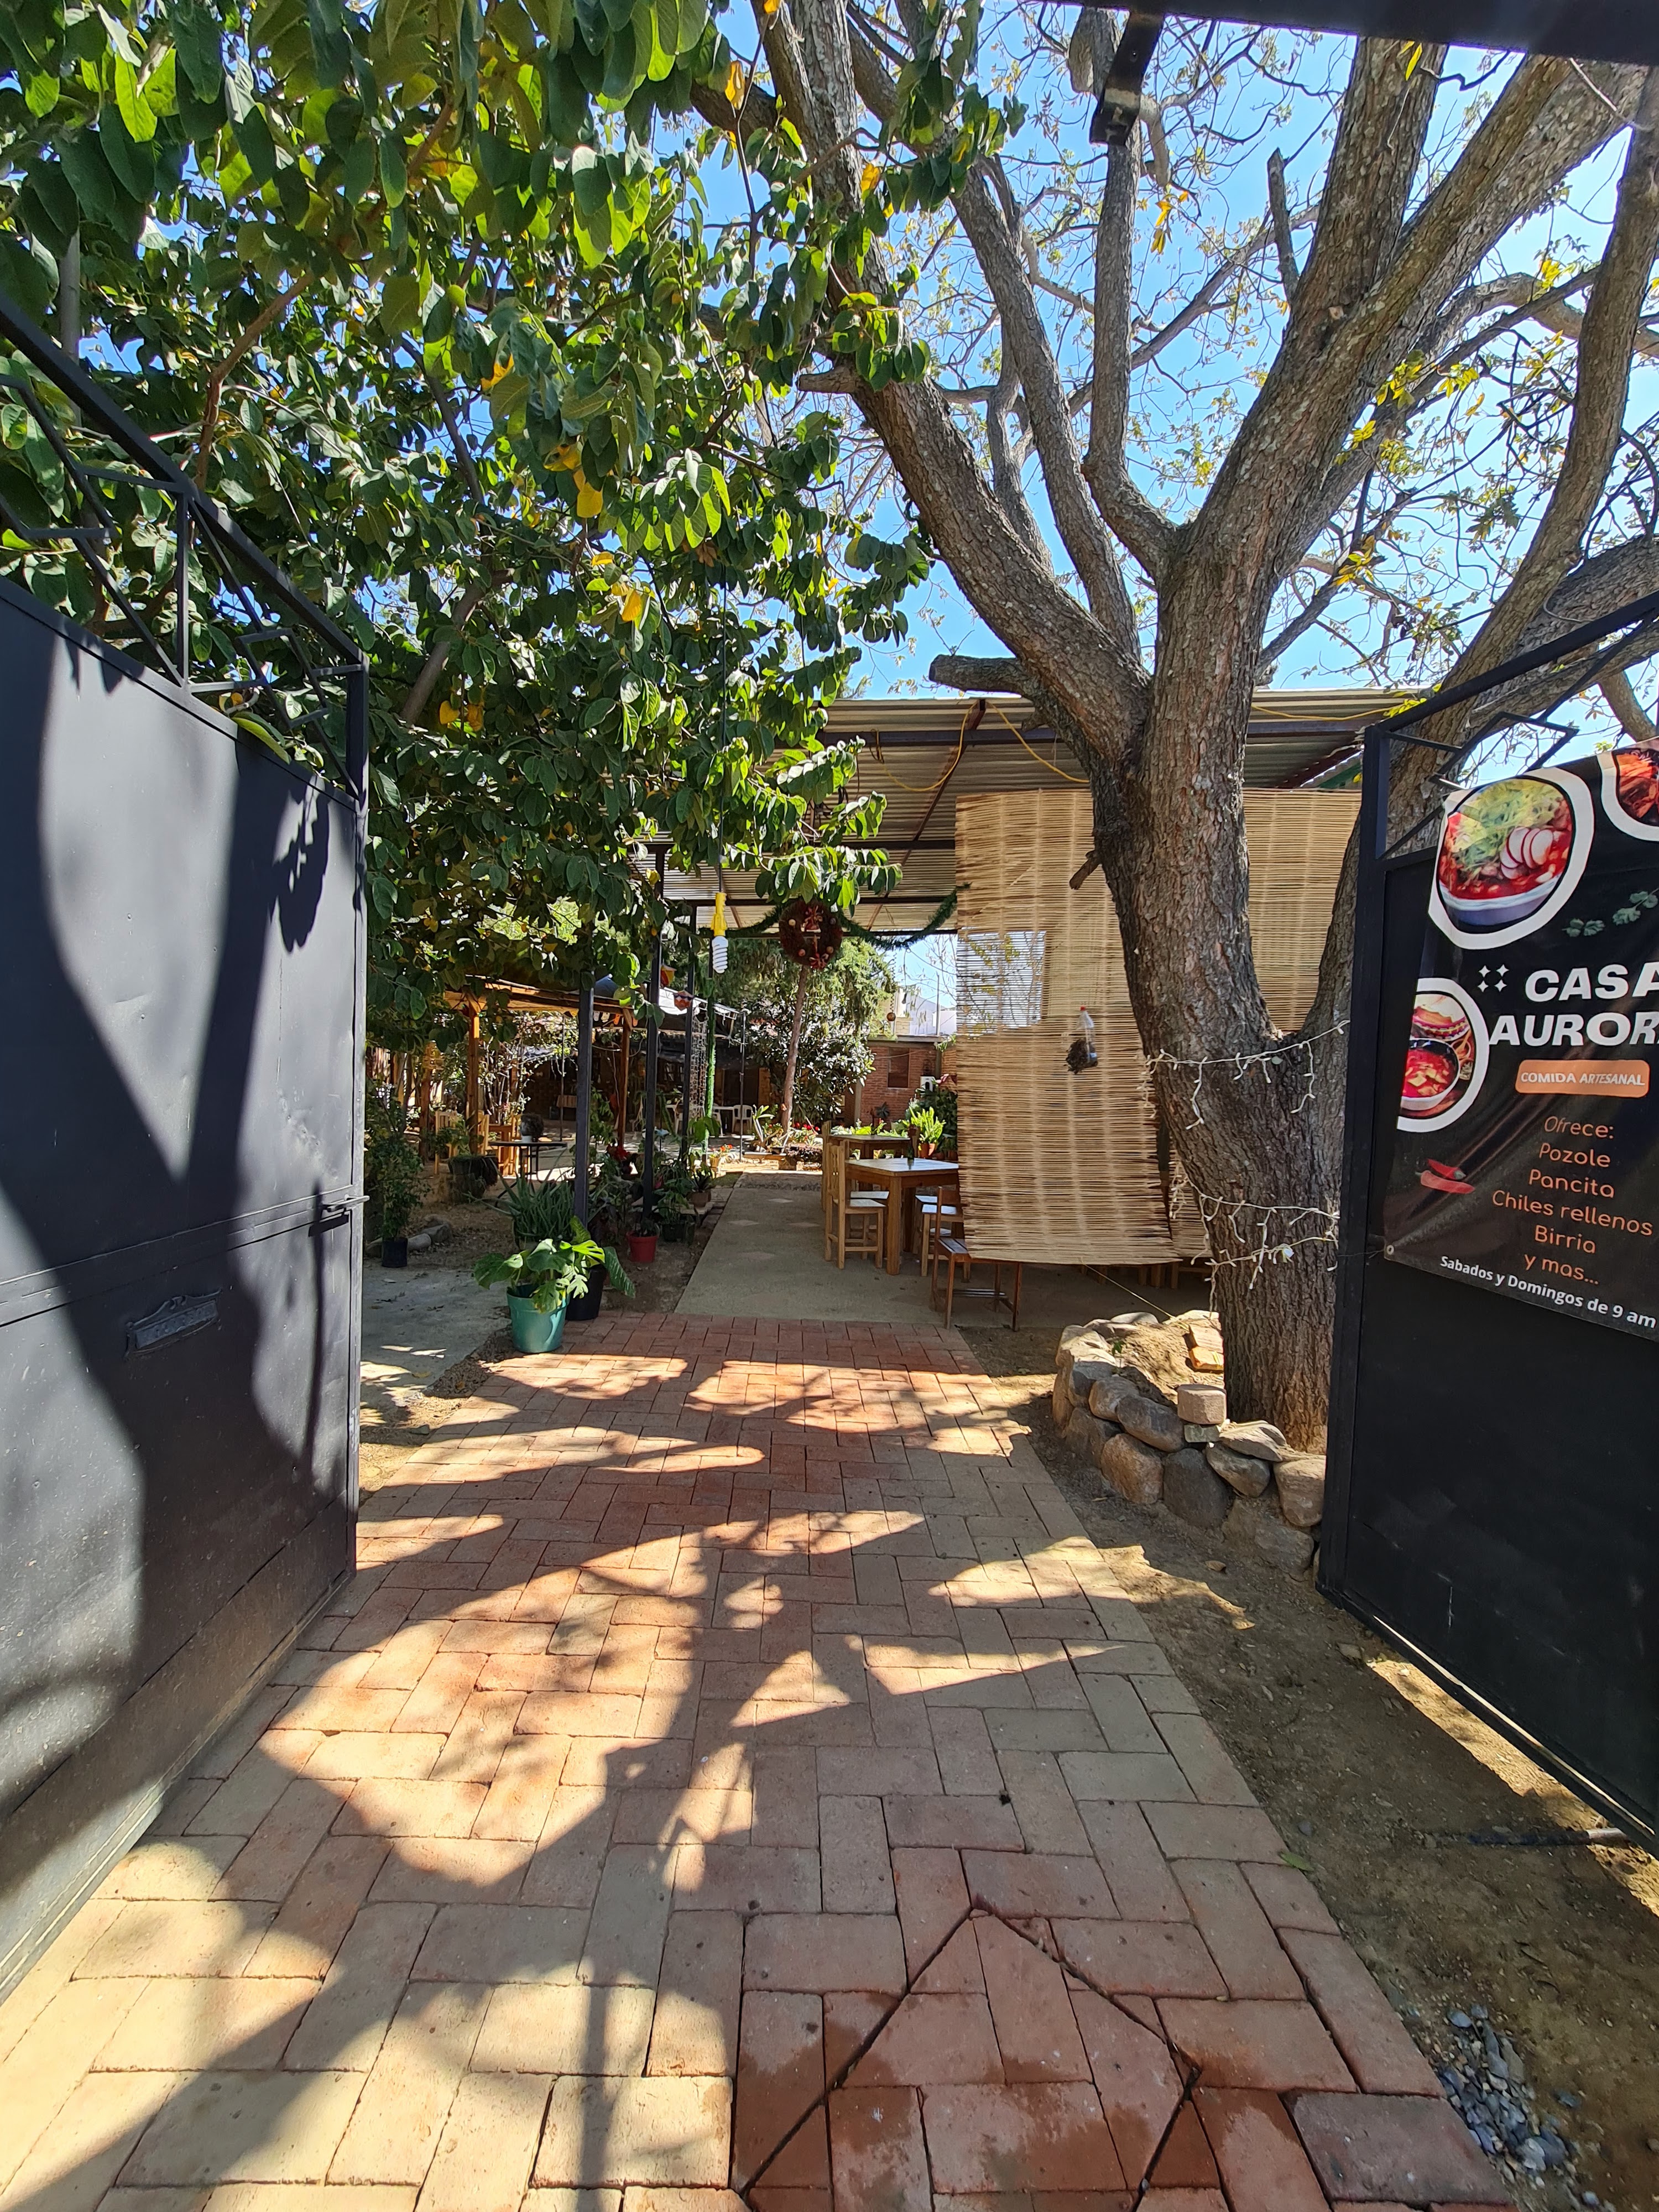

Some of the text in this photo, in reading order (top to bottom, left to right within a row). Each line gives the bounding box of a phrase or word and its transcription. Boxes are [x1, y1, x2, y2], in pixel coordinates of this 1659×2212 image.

[1525, 961, 1659, 1003] CASA
[1489, 1012, 1659, 1046] AUROR
[1520, 1072, 1645, 1086] COMIDA ARTESANAL
[1544, 1115, 1614, 1139] Ofrece:
[1539, 1142, 1610, 1167] Pozole
[1528, 1168, 1615, 1198] Pancita
[1493, 1190, 1653, 1236] Chiles rellenos
[1535, 1224, 1596, 1254] Birria
[1524, 1254, 1599, 1285] y mas...
[1441, 1256, 1657, 1328] Sabados y Domingos de 9 am
